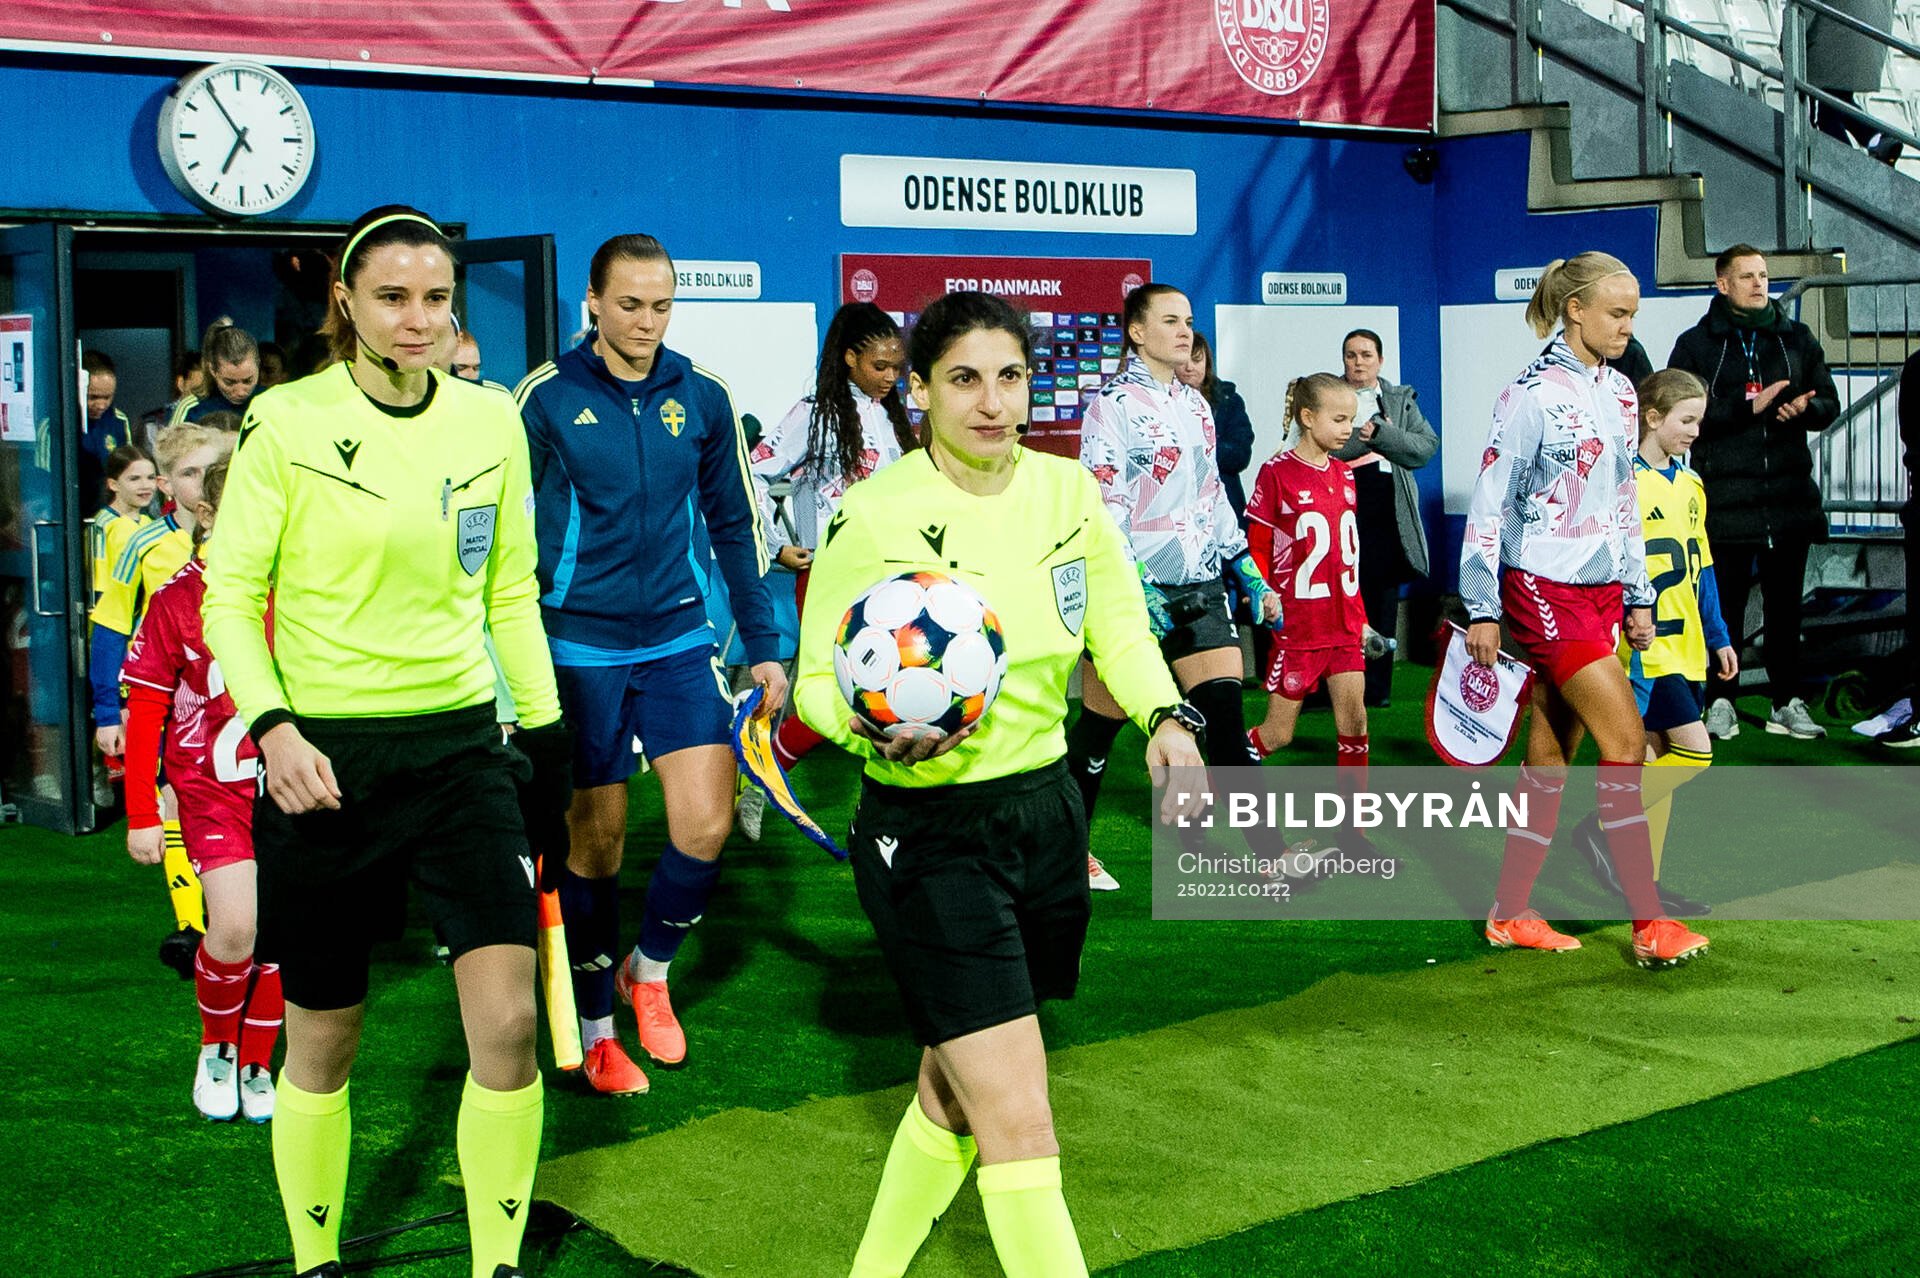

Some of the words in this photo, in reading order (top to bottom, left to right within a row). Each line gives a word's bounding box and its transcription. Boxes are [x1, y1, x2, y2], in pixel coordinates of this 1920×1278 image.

[1254, 67, 1298, 89] 1889
[904, 174, 1007, 214] ODENSE
[1015, 179, 1144, 218] BOLDKLUB
[695, 272, 754, 288] BOLDKLUB
[984, 278, 1062, 297] DANMARK
[1267, 282, 1299, 295] ODENSE
[1301, 282, 1342, 295] BOLDKLUB
[466, 535, 487, 545] MATCH
[461, 545, 488, 557] OFFICIAL
[1295, 510, 1360, 599] 29
[1063, 590, 1082, 602] MATCH
[1062, 602, 1084, 616] OFFICIAL
